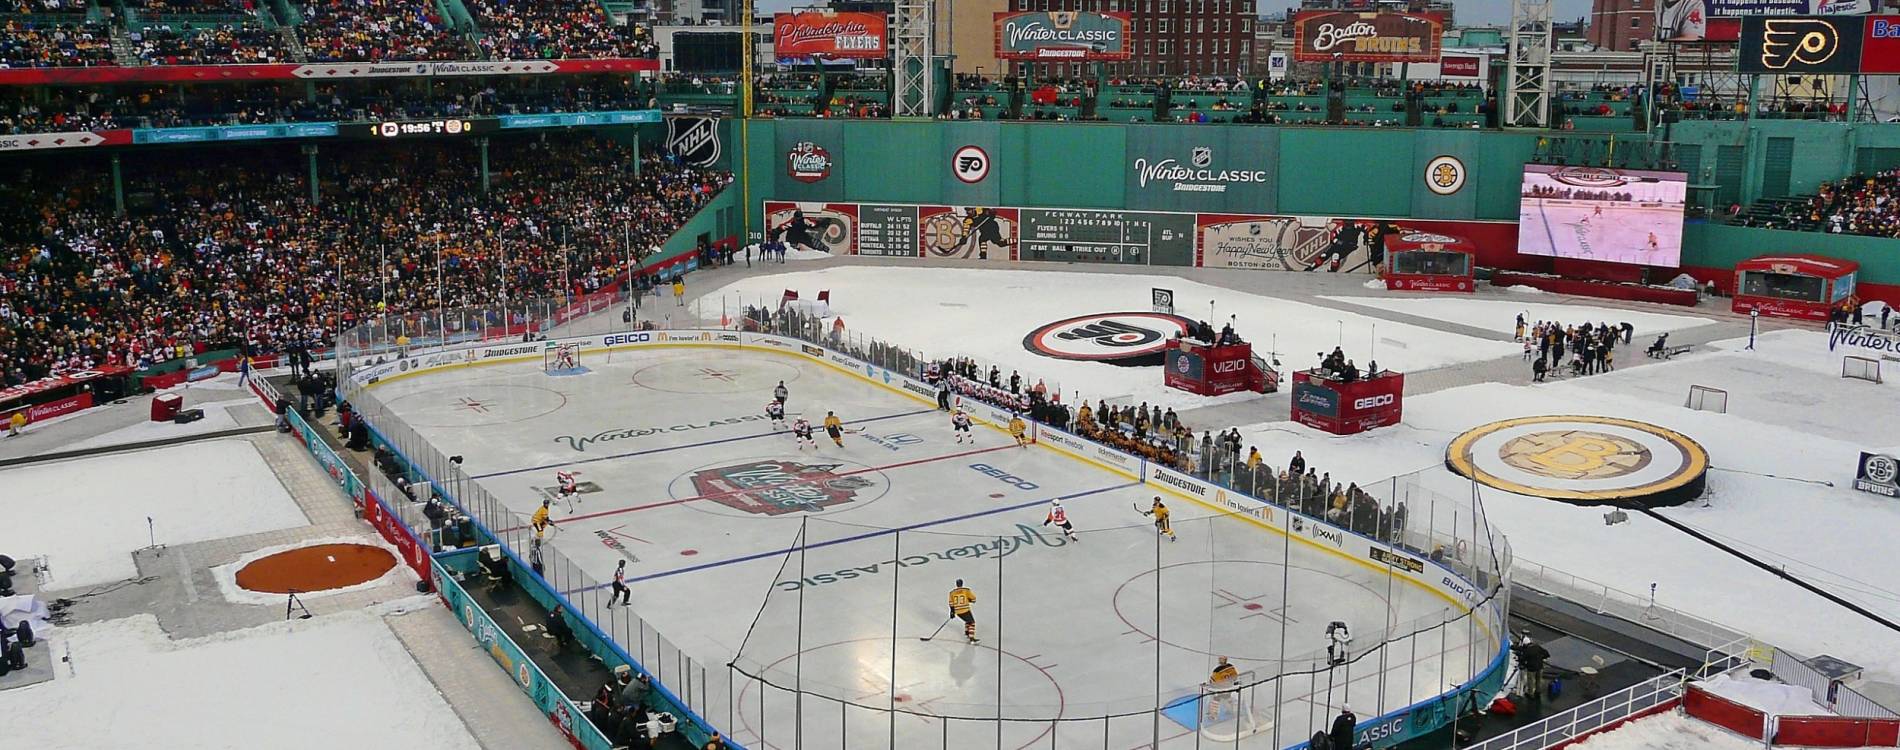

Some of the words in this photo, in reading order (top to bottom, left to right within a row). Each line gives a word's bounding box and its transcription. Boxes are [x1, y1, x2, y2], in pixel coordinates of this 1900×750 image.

[1723, 7, 1752, 17] happens
[1818, 3, 1857, 15] Majestic
[780, 21, 868, 47] Philadelphia
[835, 35, 880, 49] FLYERS
[1006, 22, 1057, 48] Winter
[1058, 30, 1116, 41] CLASSIC
[1313, 20, 1378, 51] Boston
[1038, 48, 1086, 58] BRIDGESTONE
[1354, 36, 1422, 53] BRUINS
[368, 66, 411, 74] BRIDGESTONE
[430, 63, 461, 77] Winter
[461, 65, 495, 73] CLASSIC
[371, 126, 377, 135] 1
[400, 123, 431, 134] 19:56
[463, 122, 471, 132] 0
[678, 123, 711, 157] NHL
[790, 152, 826, 171] Winter
[1134, 158, 1196, 188] Winter
[1197, 170, 1266, 182] CLASSIC
[1173, 182, 1227, 192] BRIDGESTONE
[749, 232, 762, 240] 310
[1216, 242, 1249, 259] Happy
[1300, 236, 1328, 259] NHL
[604, 333, 650, 347] GEICO
[1825, 319, 1894, 352] Winter
[483, 345, 539, 358] BRIDGESTONE
[1213, 359, 1246, 373] VIZIO
[903, 380, 936, 399] BRIDGESTONE
[29, 405, 53, 421] Winter
[52, 400, 79, 412] CLASSIC
[1354, 394, 1394, 410] GEICO
[554, 427, 669, 451] Winter
[968, 463, 1040, 490] GEICO
[1153, 468, 1207, 496] BRIDGESTONE
[1857, 481, 1895, 496] BRUINS
[934, 523, 1067, 561] Winter
[776, 555, 932, 592] CLASSIC
[1442, 576, 1464, 594] BUD
[953, 595, 966, 605] 33
